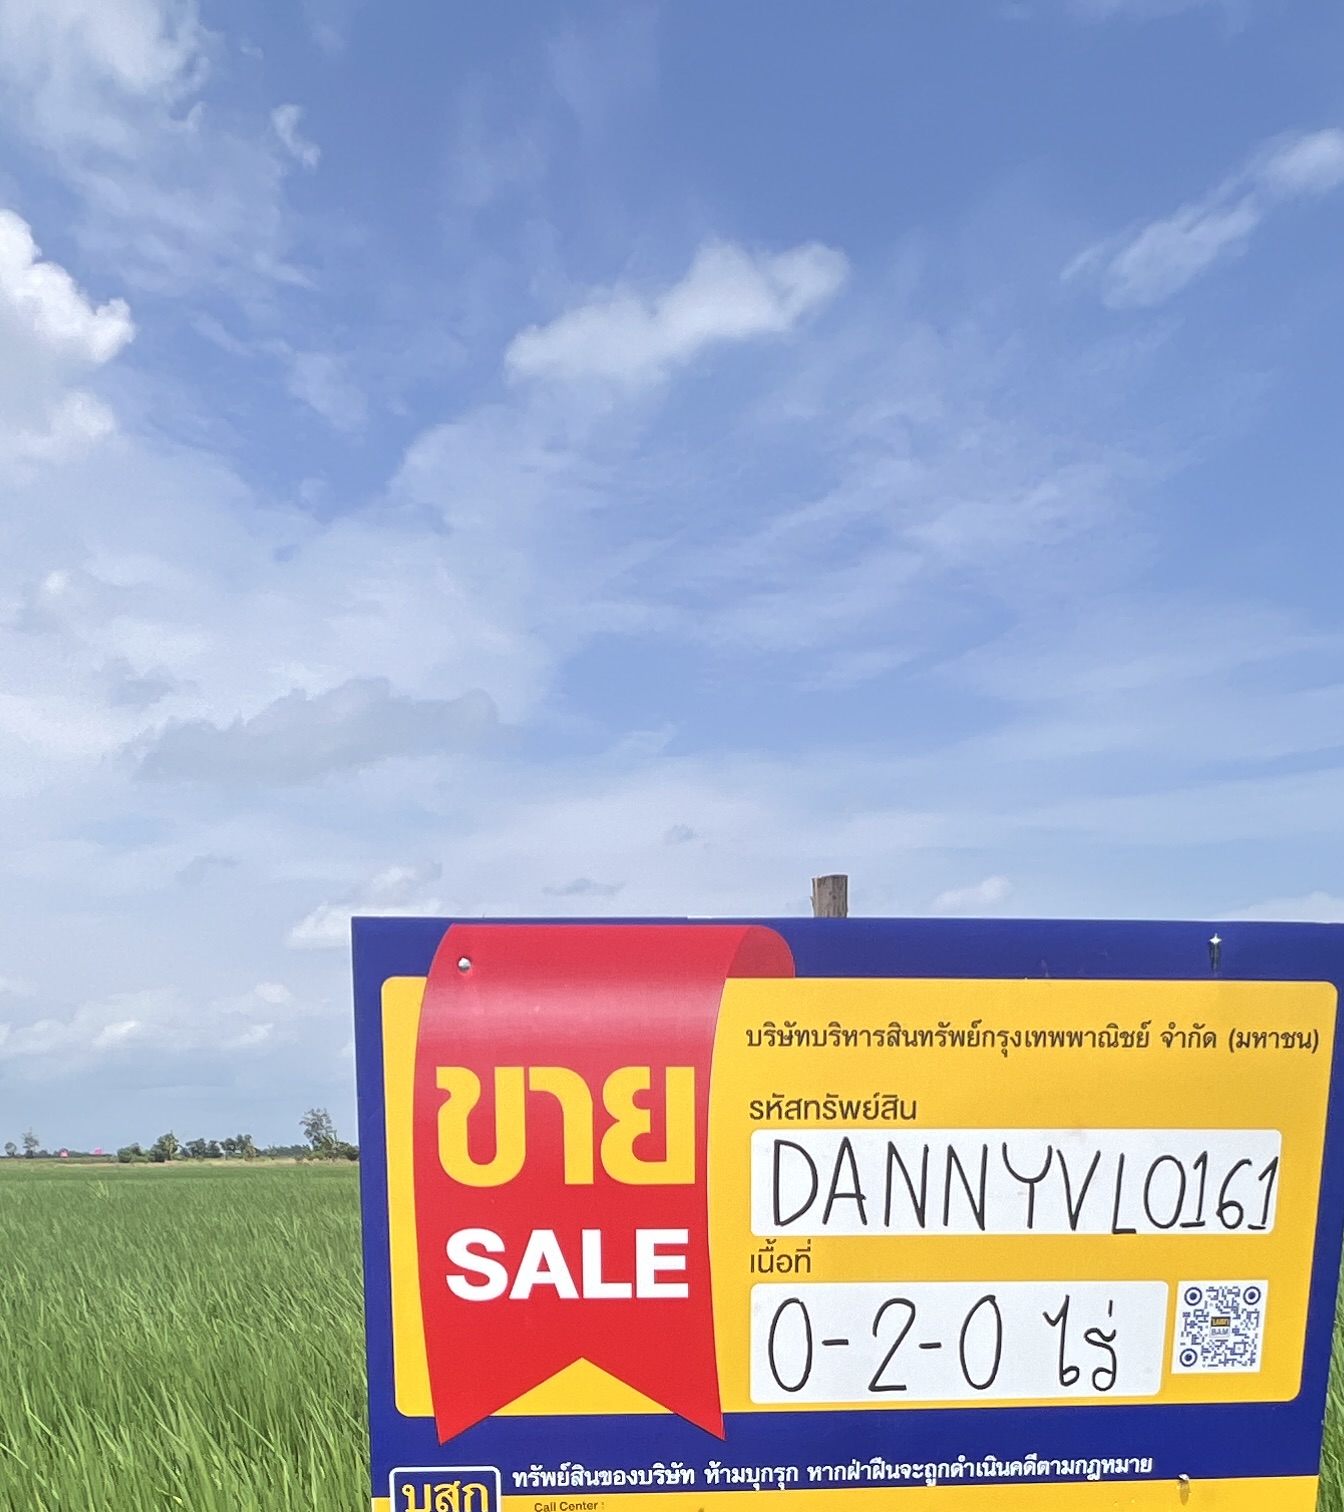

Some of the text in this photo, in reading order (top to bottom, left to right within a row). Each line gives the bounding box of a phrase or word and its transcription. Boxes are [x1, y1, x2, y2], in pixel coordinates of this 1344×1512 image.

[745, 1019, 1319, 1058] บริษัทบริหารสินทรัพย์กรุงเทพพาณิชย์ จำกัด (มหาชน)
[749, 1092, 917, 1121] รหัสทรัพย์สิน
[436, 1066, 696, 1188] ขาย
[446, 1228, 689, 1301] SALE
[749, 1239, 812, 1274] เนื้อที่
[768, 1294, 1117, 1392] 0-2-0 ไร่
[512, 1463, 695, 1488] ทรัพย์สินของบริษัท
[704, 1461, 799, 1491] ห้ามบุกรุก
[534, 1502, 557, 1512] Call
